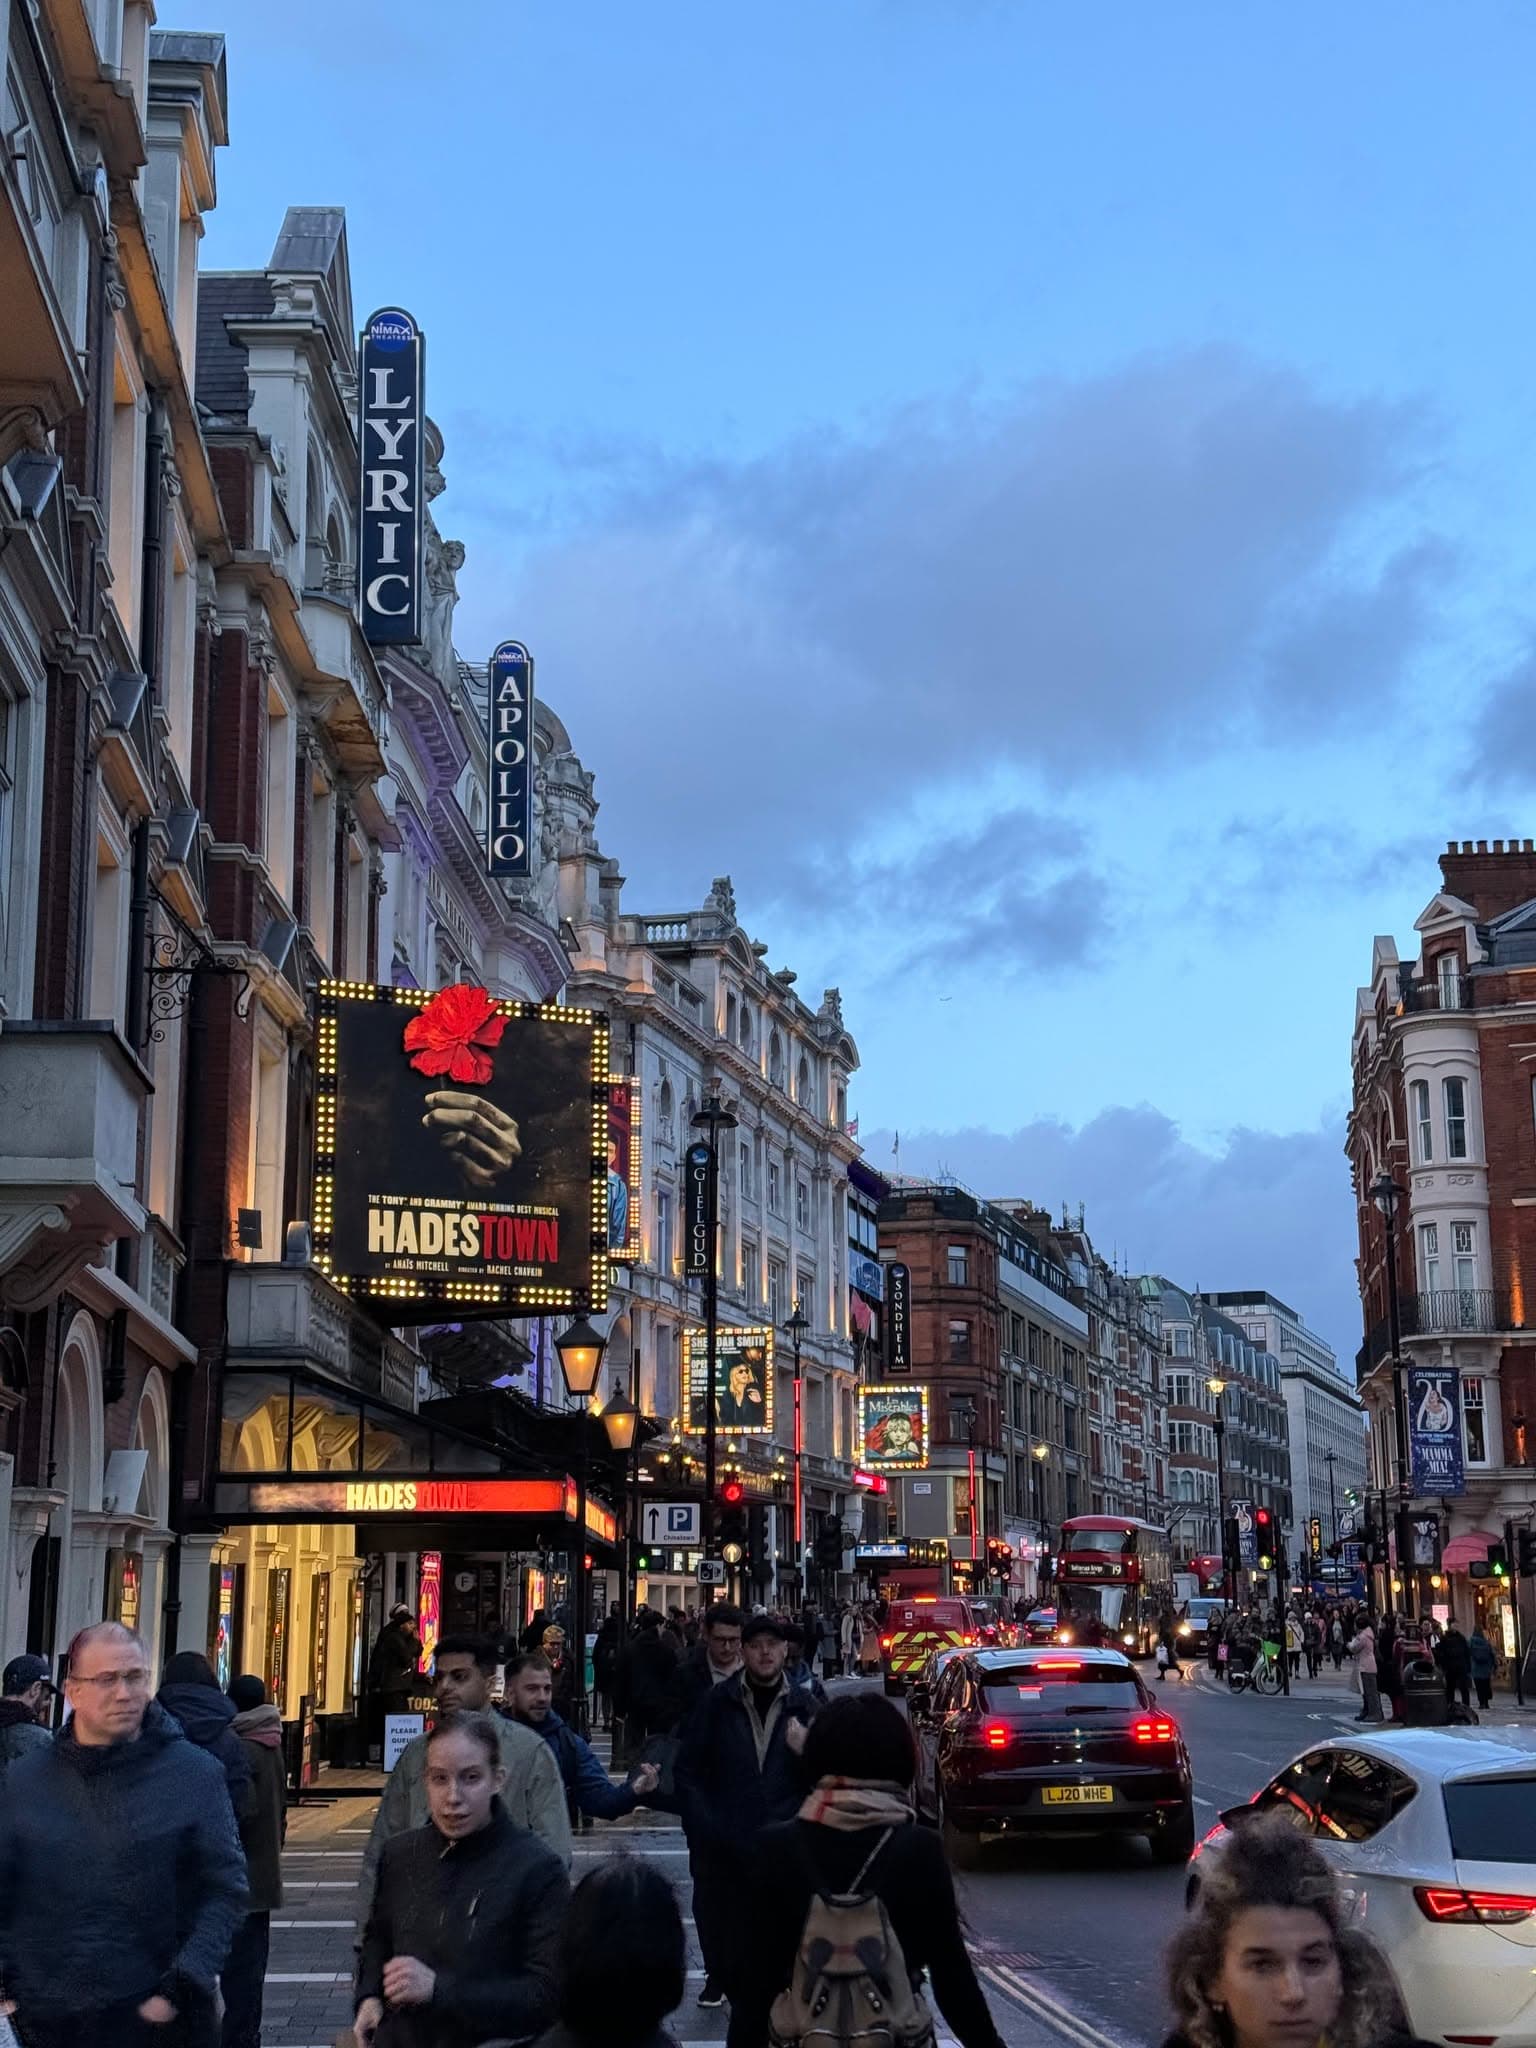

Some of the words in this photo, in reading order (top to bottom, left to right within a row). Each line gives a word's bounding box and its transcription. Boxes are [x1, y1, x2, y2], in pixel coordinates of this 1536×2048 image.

[371, 322, 410, 334] NIMAX
[365, 368, 415, 616] LYRIC
[494, 676, 525, 860] APOLLO
[368, 1194, 380, 1203] THE
[409, 1197, 422, 1206] AND
[466, 1201, 515, 1213] AWARD-WINNING
[517, 1204, 531, 1214] BEST
[533, 1206, 559, 1217] MUSICAL
[693, 1167, 706, 1267] GIELGUD
[368, 1209, 559, 1263] HADESTOWN
[416, 1260, 449, 1272] MITCHELL
[487, 1265, 512, 1276] RACHEL
[514, 1266, 543, 1277] CHAVKIN
[894, 1280, 904, 1364] SONDHEIM
[691, 1336, 734, 1347] SHEDAN
[737, 1336, 765, 1347] SMITH
[869, 1400, 918, 1412] Misérables
[1416, 1379, 1453, 1432] 25
[1422, 1447, 1453, 1460] MAMMA
[1429, 1461, 1448, 1473] MIA!
[1112, 1564, 1122, 1575] 19
[1047, 1788, 1080, 1801] LJ20
[1083, 1787, 1107, 1800] WHE
